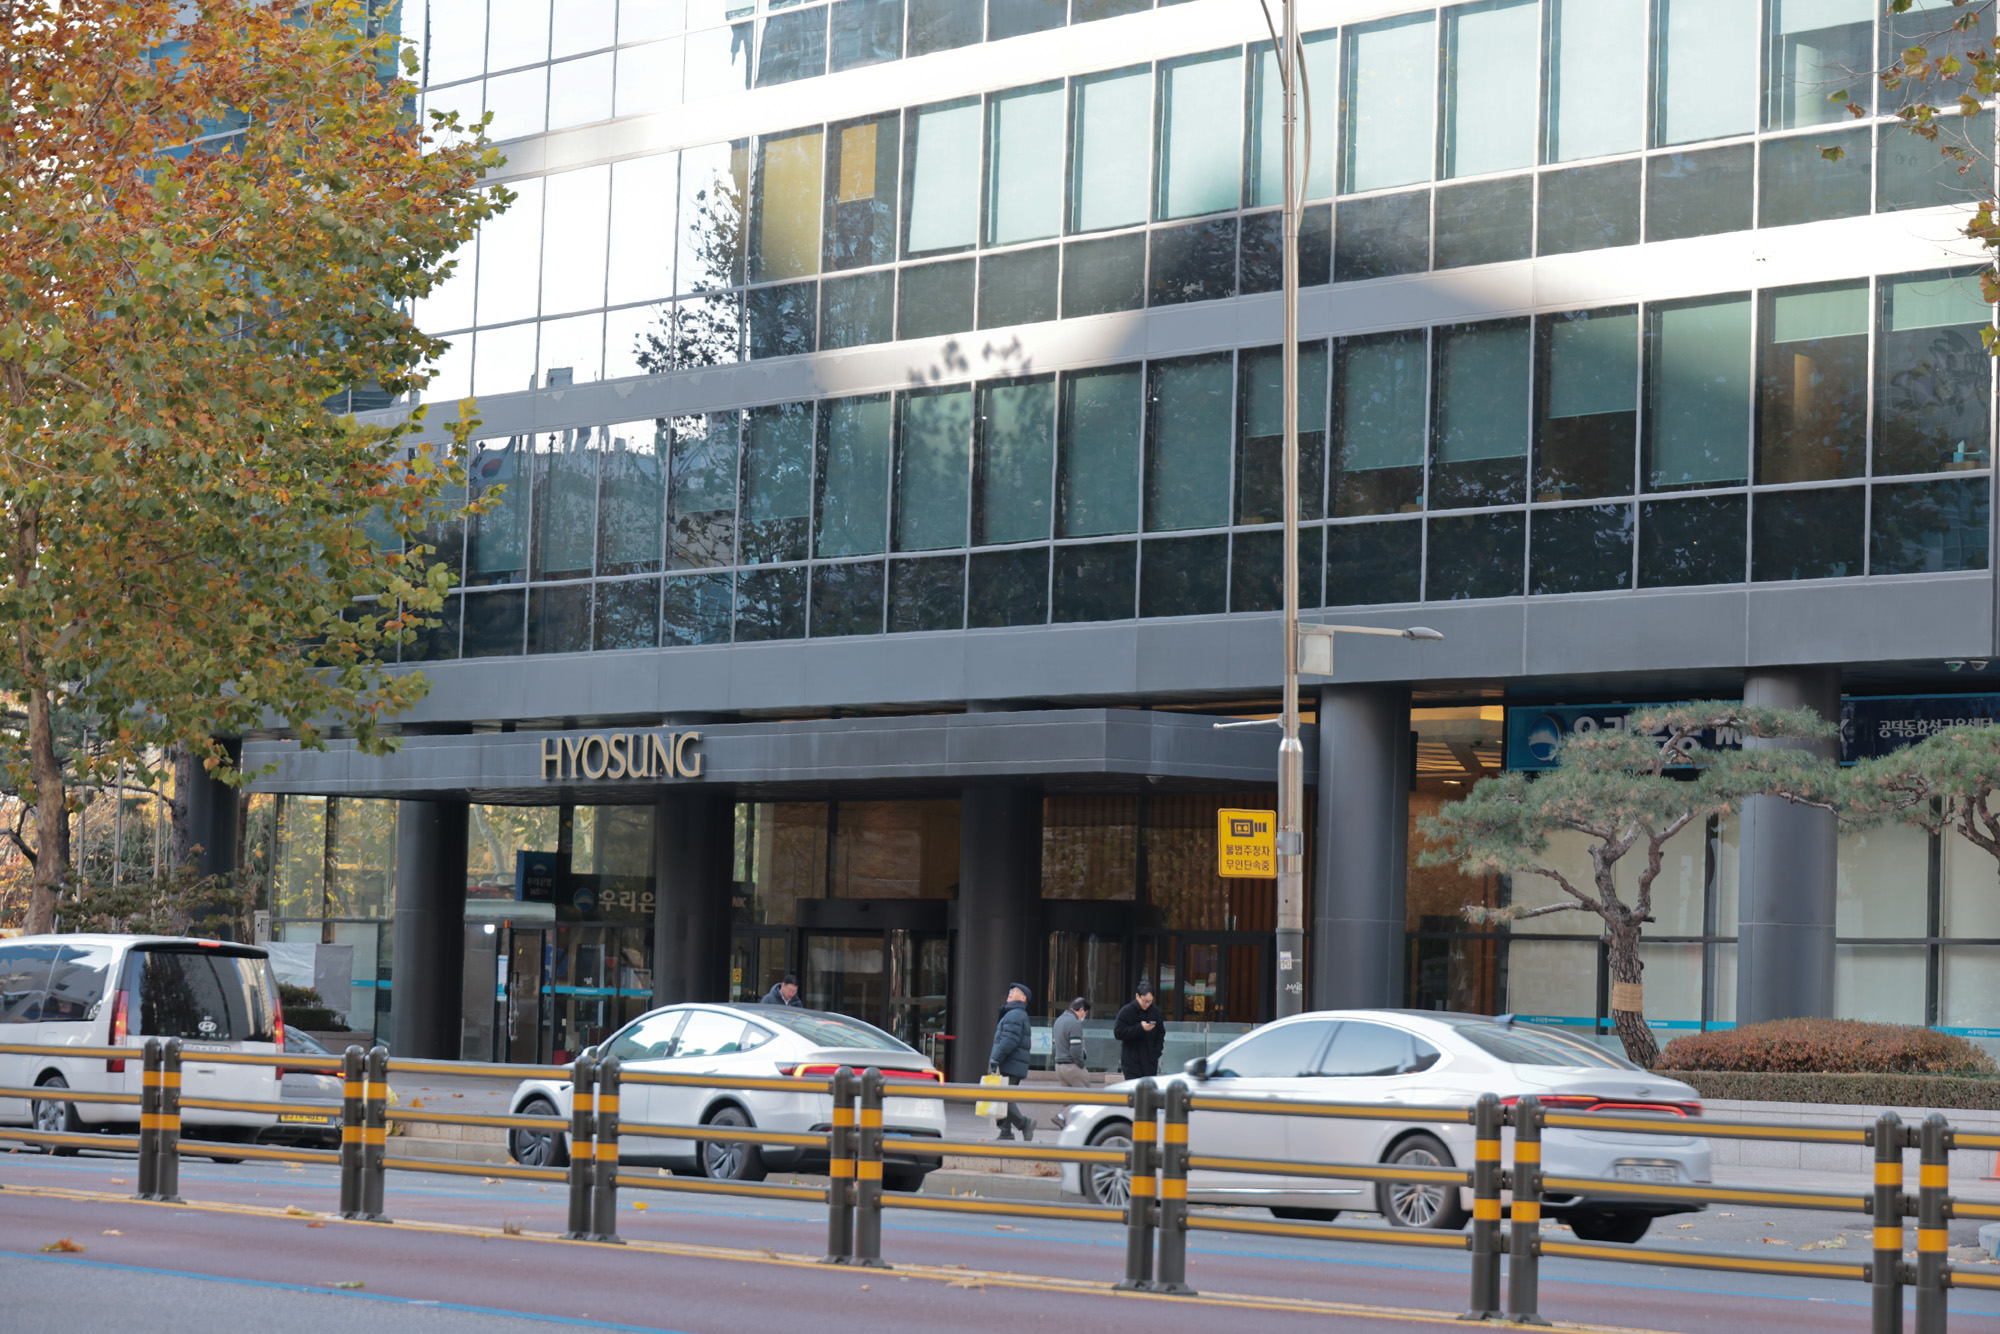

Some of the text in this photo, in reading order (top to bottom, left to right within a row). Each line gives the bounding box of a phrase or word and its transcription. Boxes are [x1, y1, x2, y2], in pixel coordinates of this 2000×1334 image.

[541, 732, 702, 779] HYOSUNG
[1226, 844, 1270, 856] 불법주정차
[1226, 859, 1270, 871] 무인단속중
